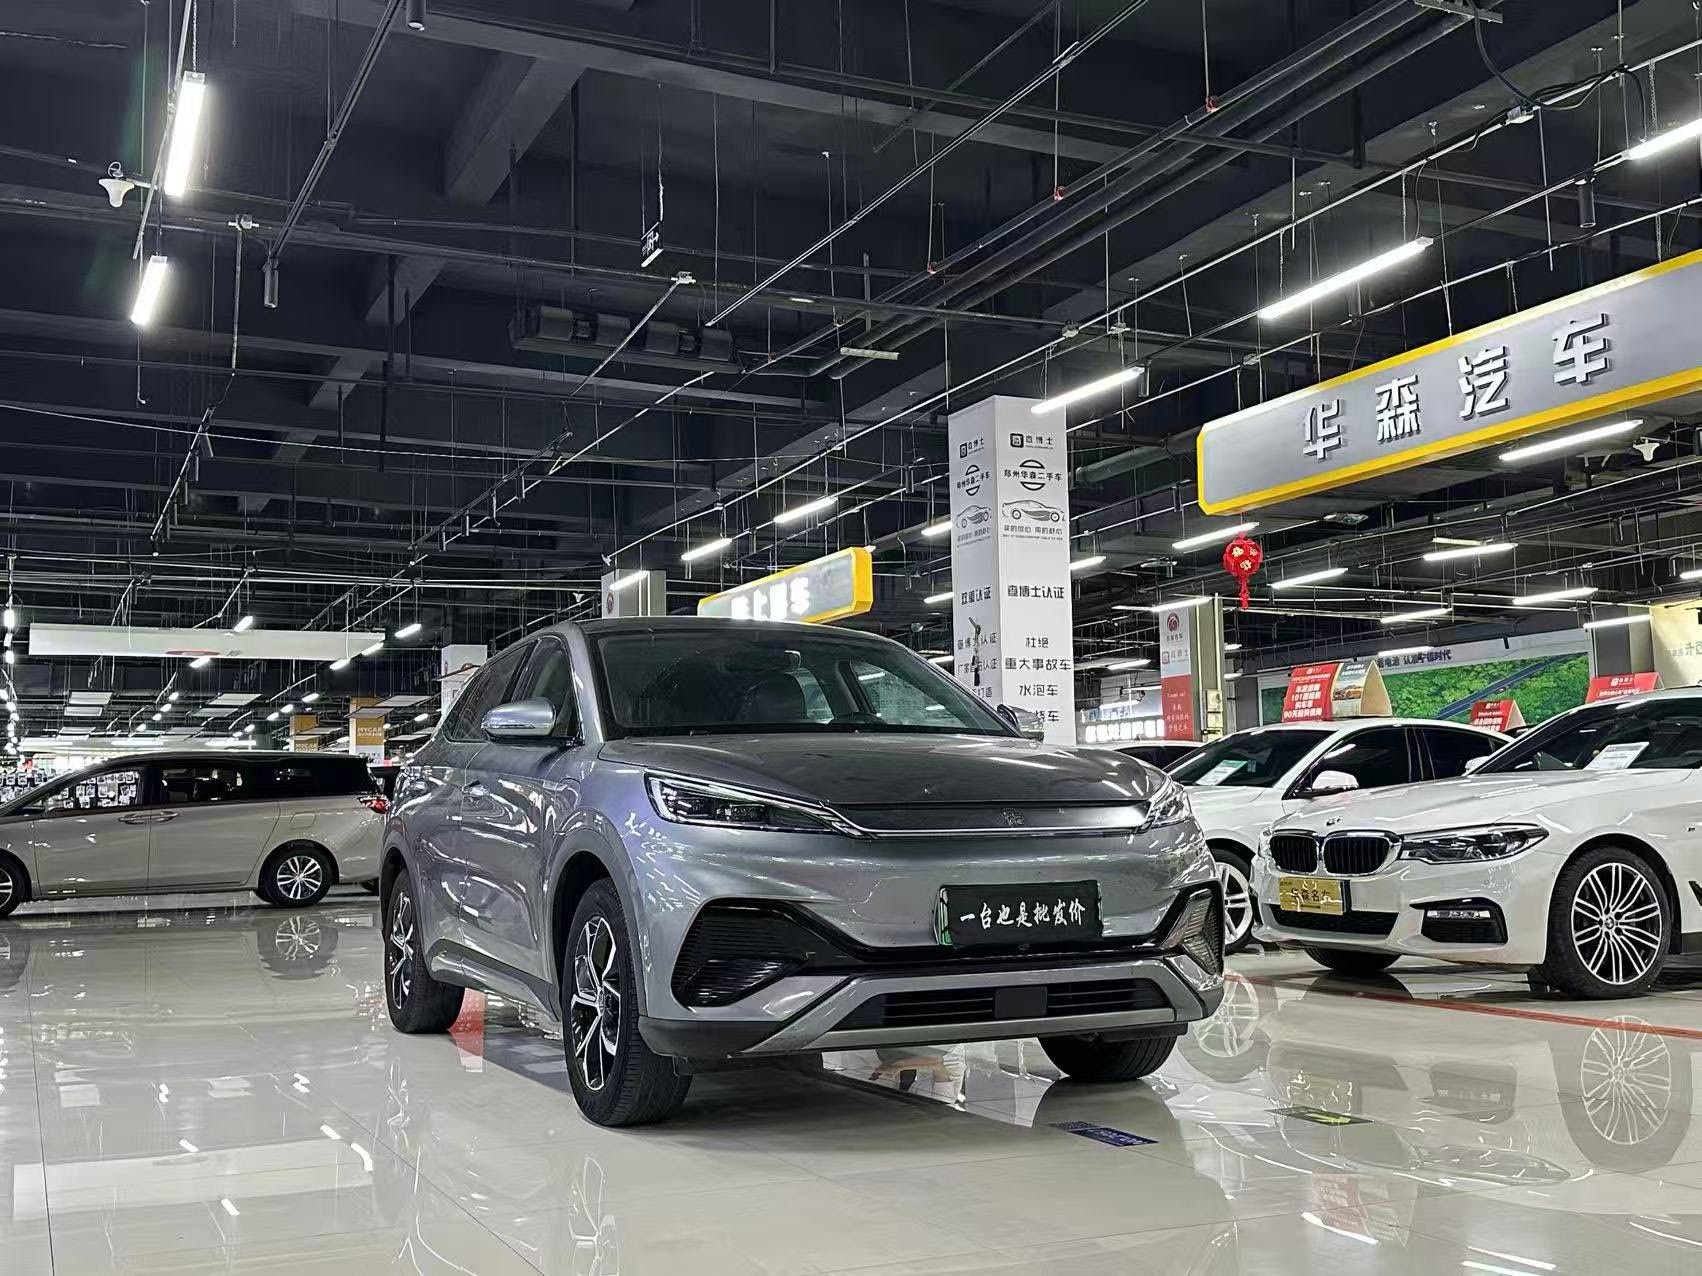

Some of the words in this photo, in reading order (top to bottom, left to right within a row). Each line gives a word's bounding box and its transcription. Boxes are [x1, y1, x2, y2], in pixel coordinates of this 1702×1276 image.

[1301, 312, 1611, 460] 华森汽车
[1004, 469, 1062, 482] 郑州华森二手车
[961, 586, 991, 606] 双重认证
[1007, 584, 1065, 599] 查博士认证
[1025, 636, 1049, 648] 杜绝
[1005, 657, 1072, 671] 重大事故车
[1019, 684, 1059, 697] 水泡车
[959, 897, 1086, 930] 一台也是批发价
